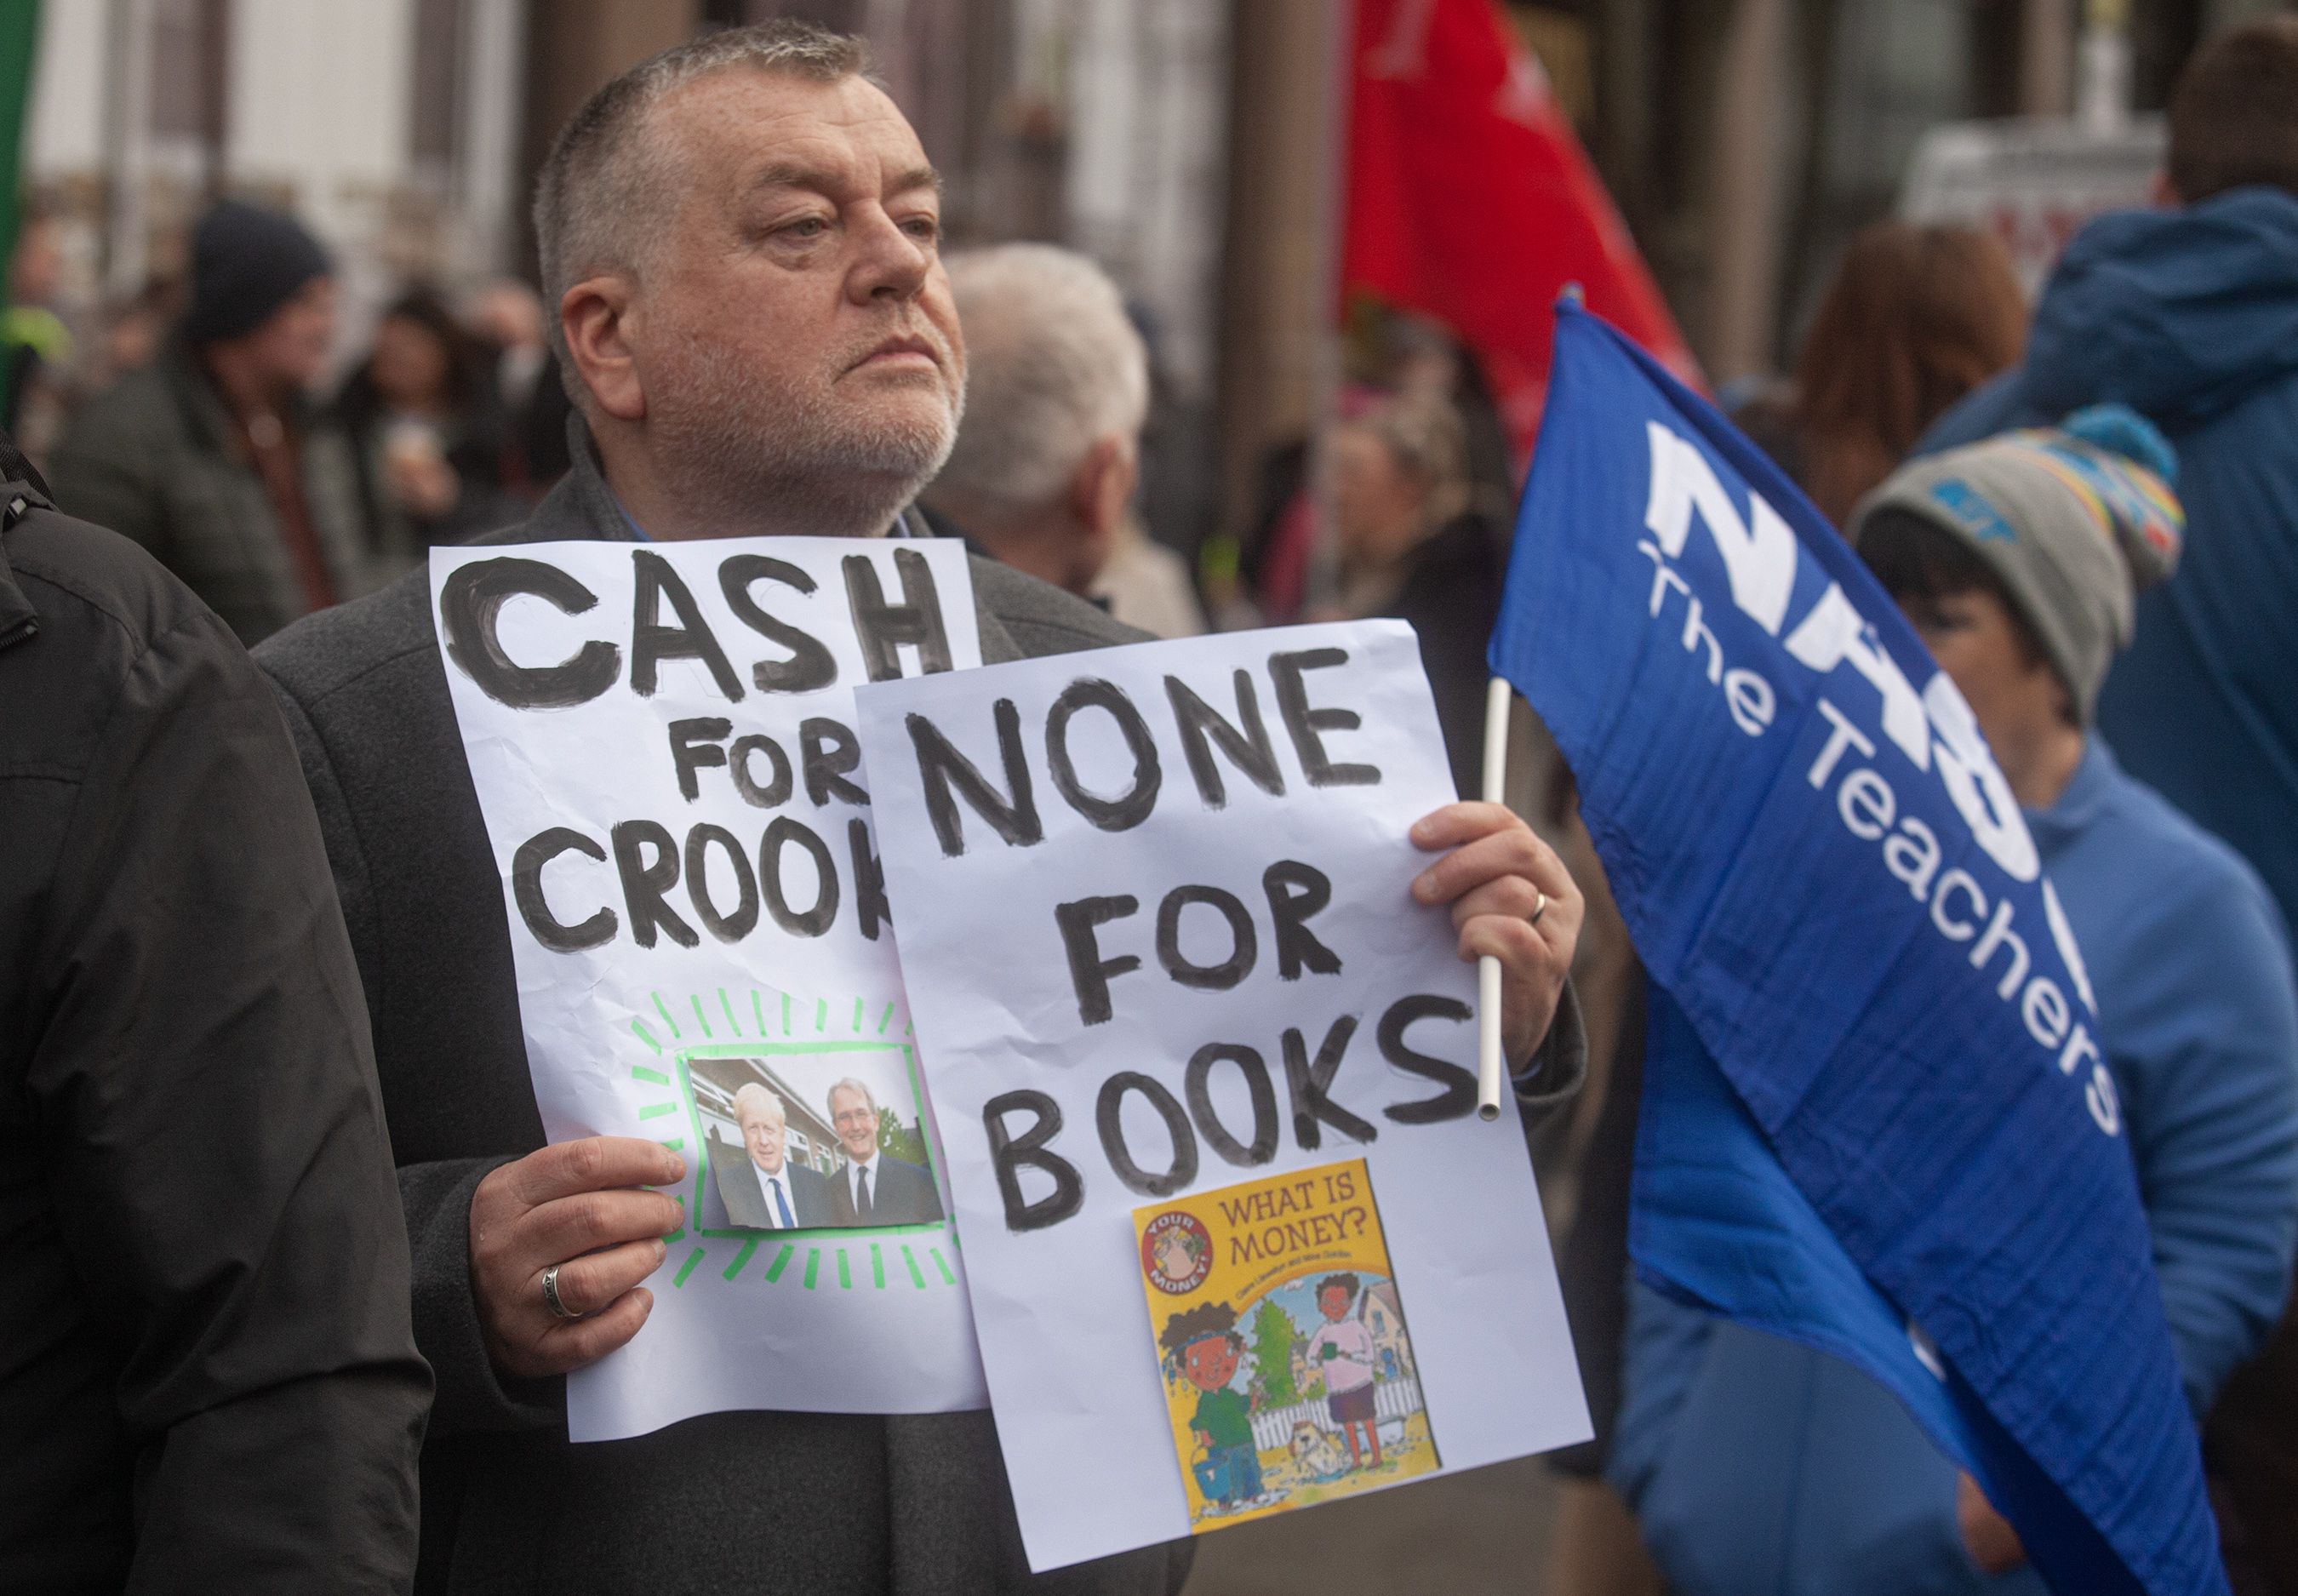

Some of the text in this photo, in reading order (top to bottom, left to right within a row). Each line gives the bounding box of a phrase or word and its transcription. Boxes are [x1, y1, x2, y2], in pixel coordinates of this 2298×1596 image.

[439, 547, 954, 711] CASH
[668, 717, 871, 808] FOR
[905, 647, 1382, 859] NONE
[1637, 539, 2119, 1137] The Teachers
[1055, 860, 1343, 1026] FOR
[982, 993, 1479, 1232] BOOKS
[1147, 1213, 1194, 1234] YOUR
[1219, 1170, 1356, 1227] WHAT IS
[1230, 1205, 1368, 1266] MONEY?
